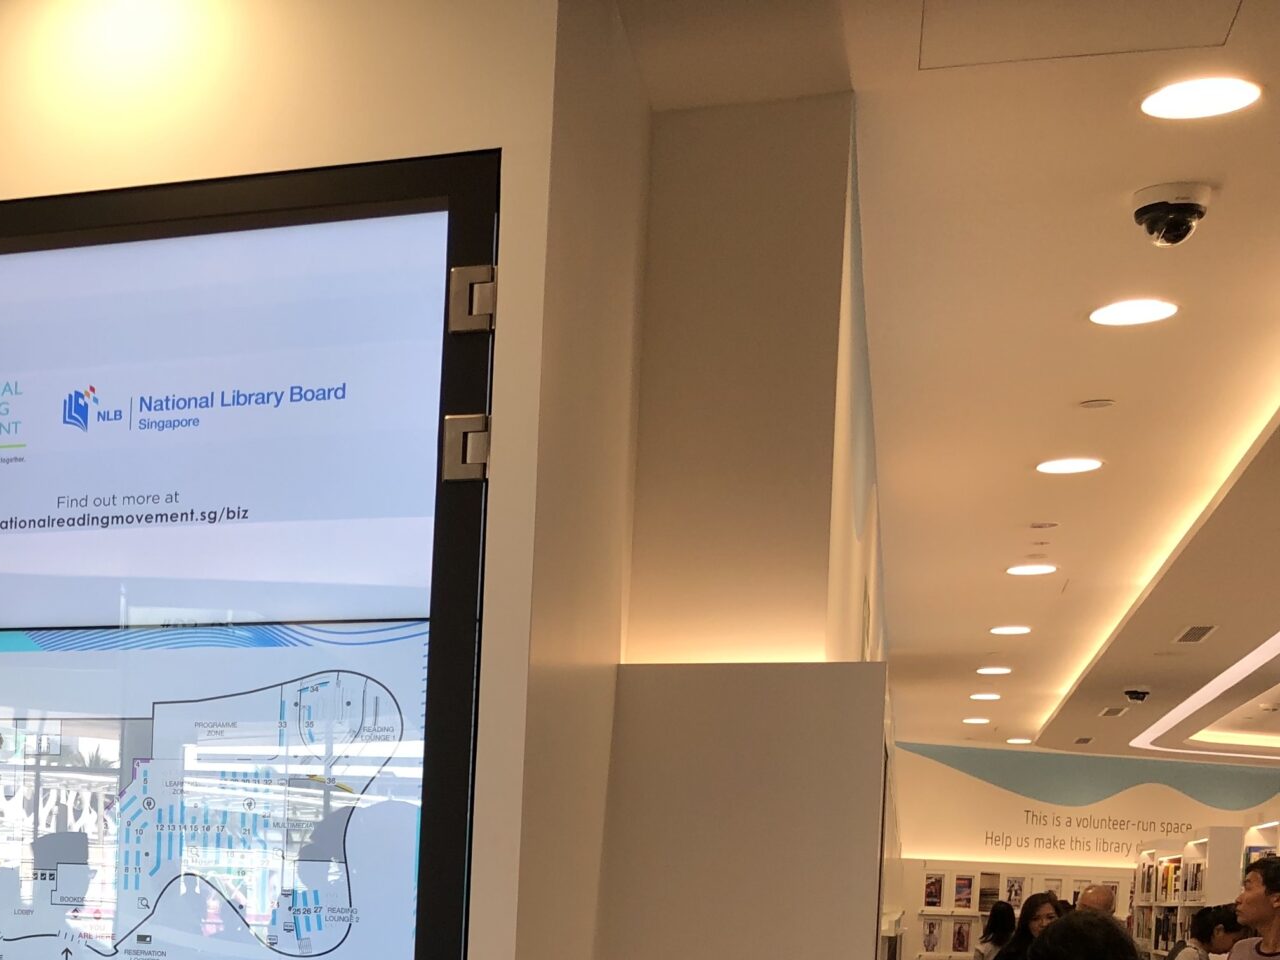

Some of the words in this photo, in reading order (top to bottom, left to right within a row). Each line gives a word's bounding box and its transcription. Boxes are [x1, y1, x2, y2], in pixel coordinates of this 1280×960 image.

[139, 391, 214, 412] National
[220, 390, 284, 408] Library
[289, 382, 347, 403] Board
[96, 410, 123, 422] NLB
[138, 417, 200, 431] Singapore
[57, 495, 88, 509] Find
[93, 494, 117, 508] out
[122, 493, 160, 506] more
[164, 491, 179, 504] at
[1024, 809, 1048, 826] This
[1052, 812, 1061, 827] is
[1065, 816, 1072, 827] a
[1076, 815, 1156, 833] volunteer-run
[985, 831, 1012, 851] Help
[1016, 837, 1030, 848] us
[1034, 836, 1066, 851] make
[1070, 837, 1091, 852] this
[1095, 838, 1132, 857] library
